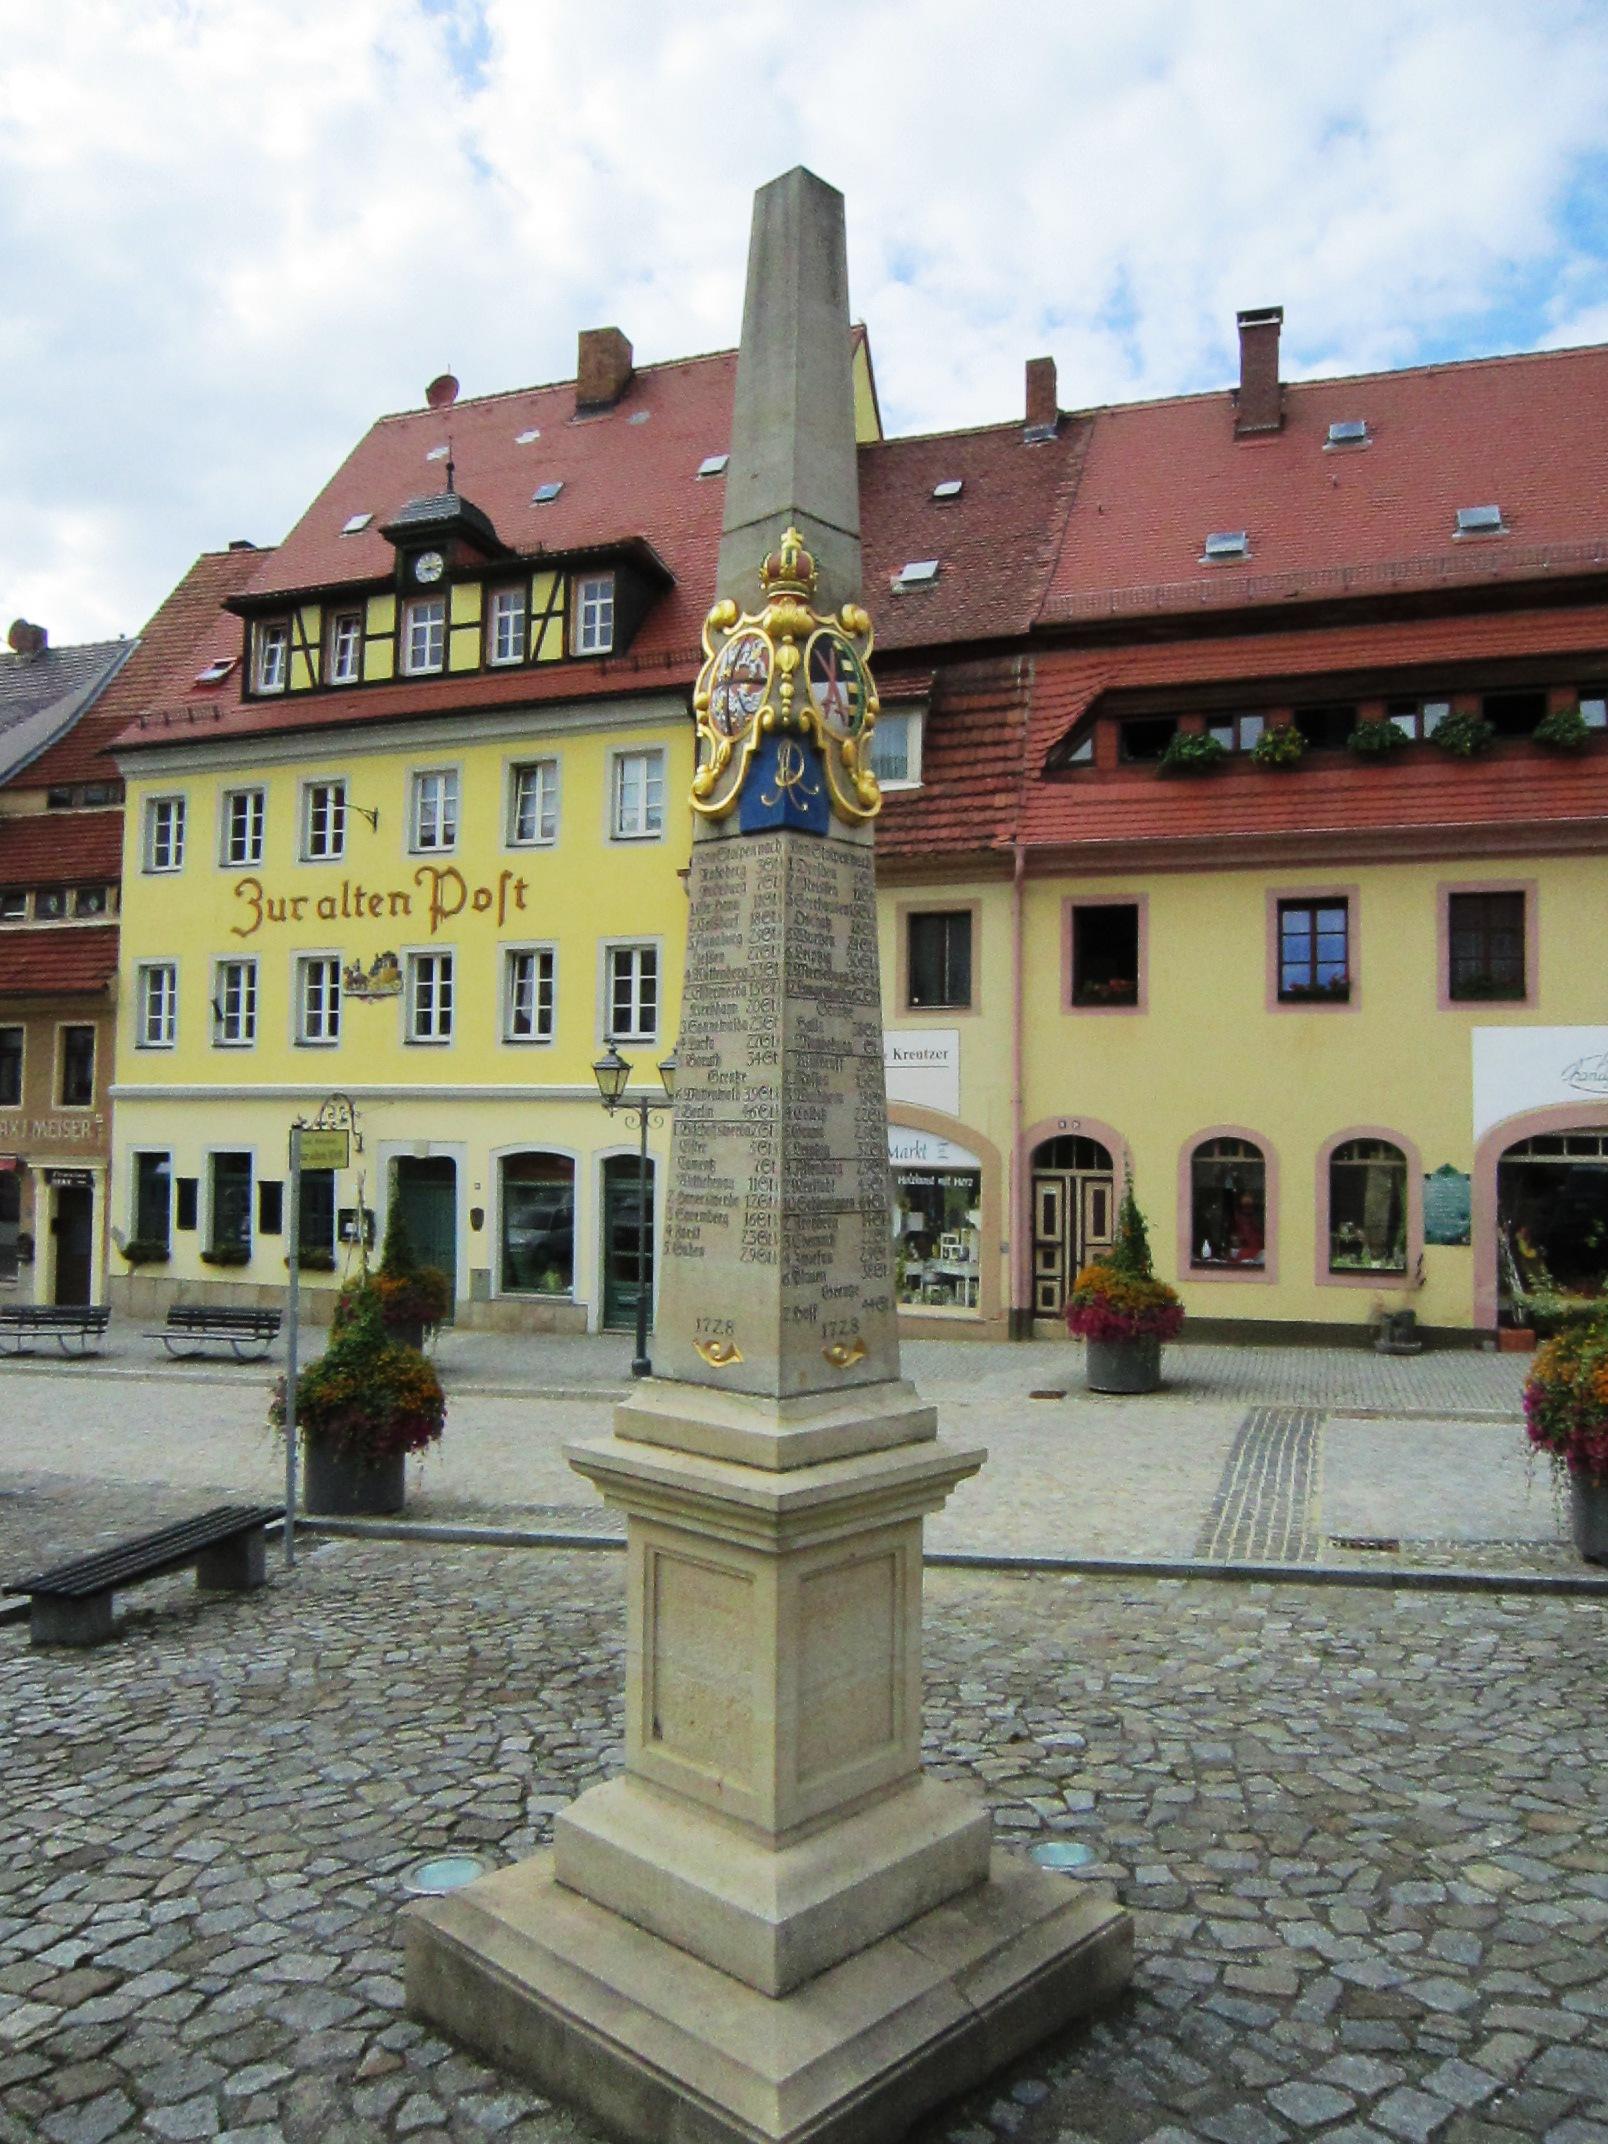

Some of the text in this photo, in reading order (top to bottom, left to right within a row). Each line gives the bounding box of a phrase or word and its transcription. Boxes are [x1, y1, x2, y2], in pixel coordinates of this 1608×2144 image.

[230, 865, 530, 938] Zur alten Post
[893, 1048, 949, 1060] Kreutzer
